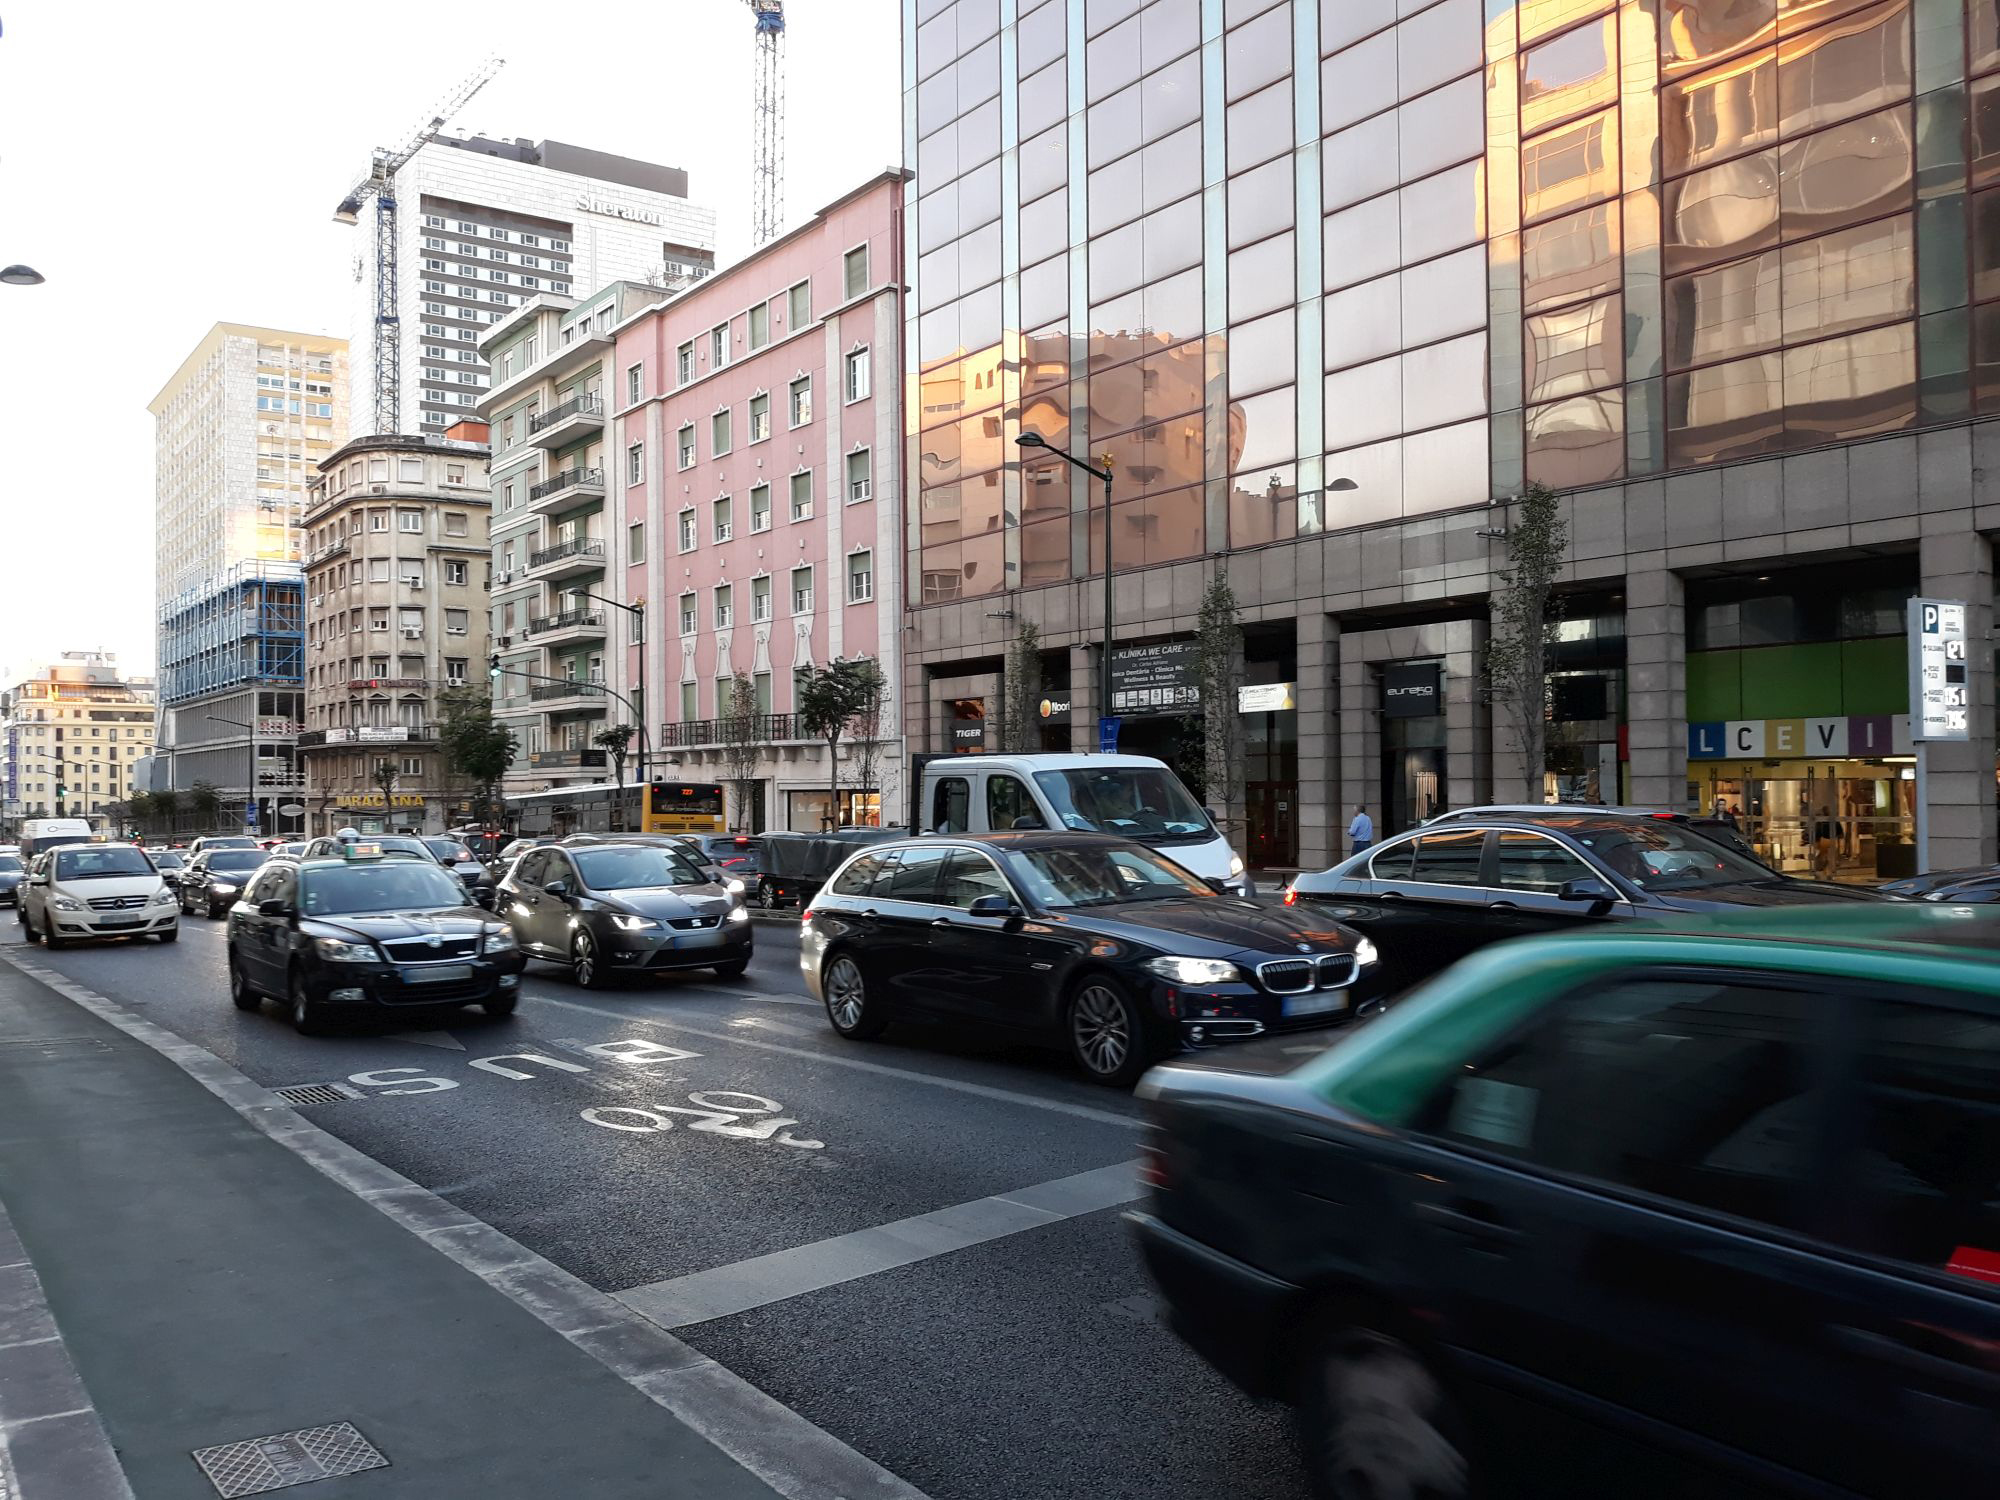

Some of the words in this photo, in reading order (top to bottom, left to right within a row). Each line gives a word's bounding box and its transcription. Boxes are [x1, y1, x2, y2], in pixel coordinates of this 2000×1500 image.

[576, 192, 664, 226] Sheraton
[1925, 607, 1937, 631] P
[1148, 647, 1161, 656] WE
[1161, 645, 1183, 654] CARE
[956, 729, 982, 738] TIGER
